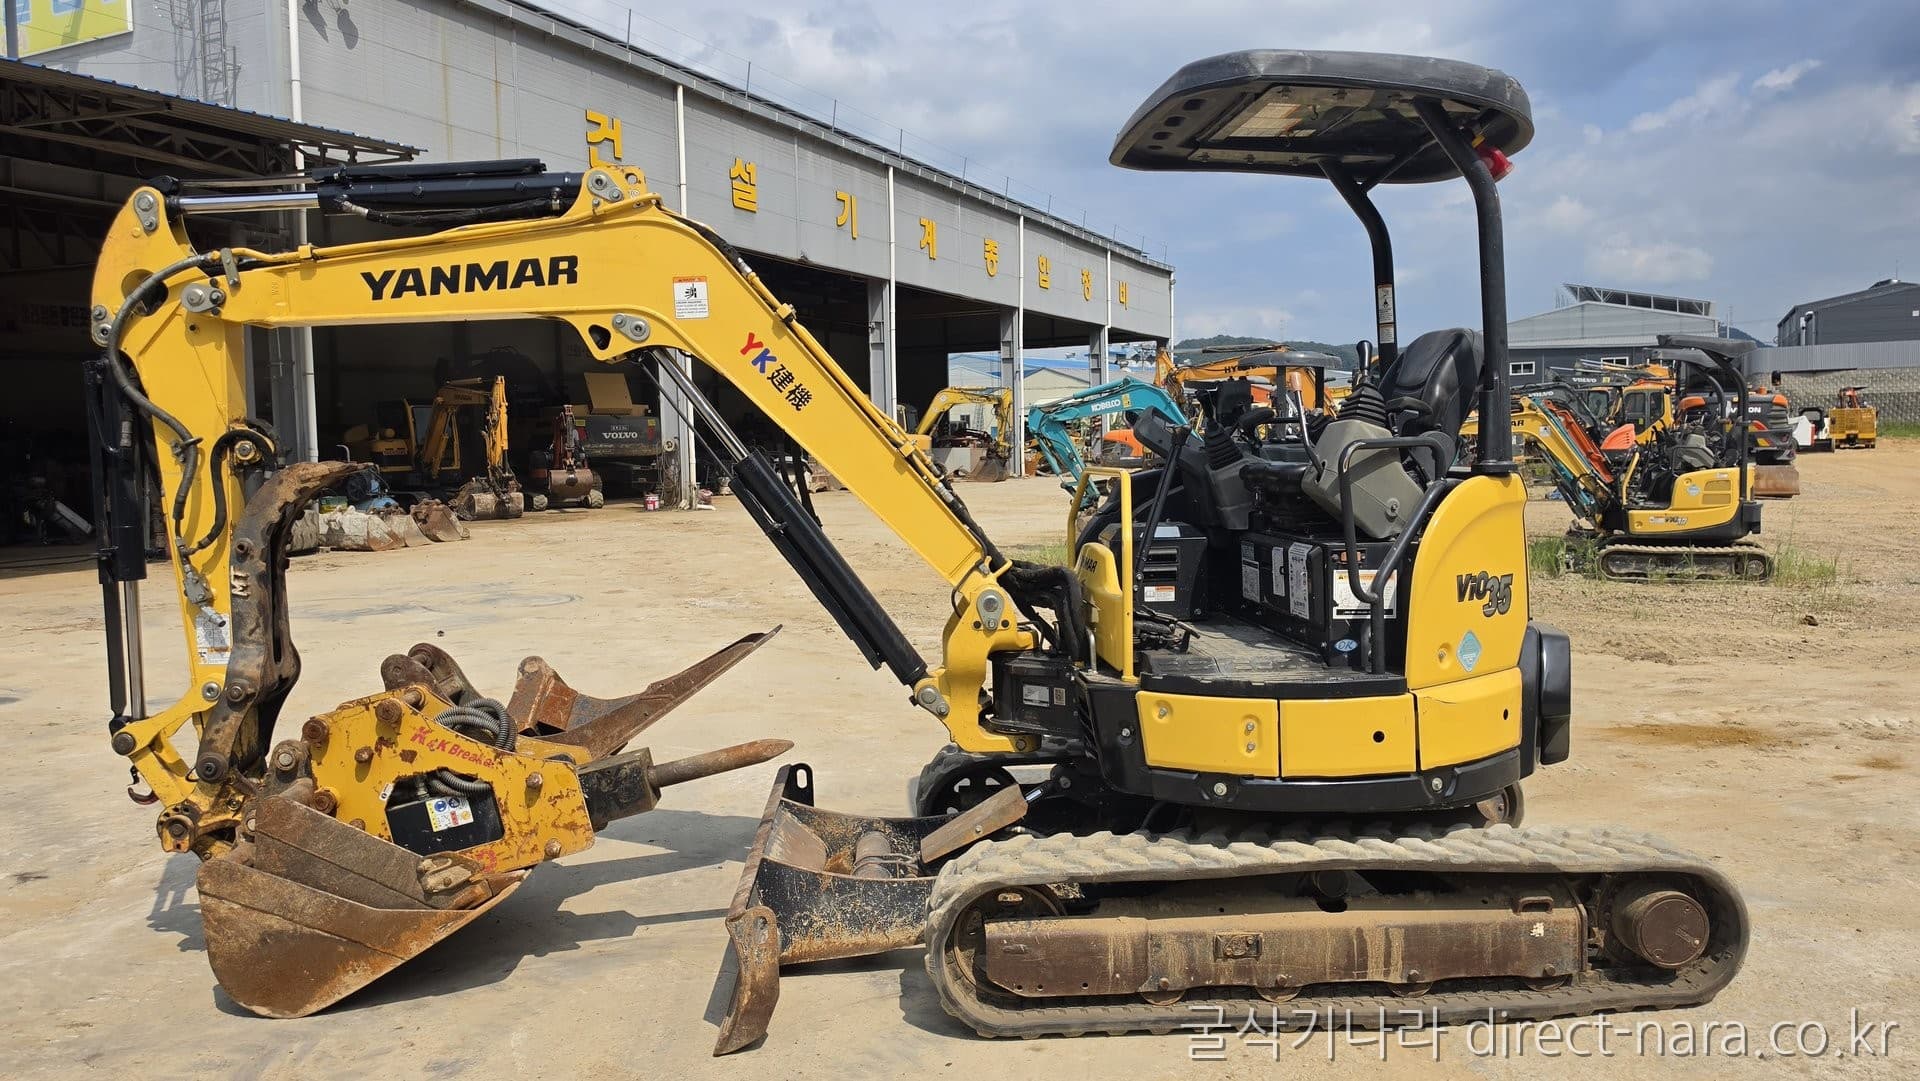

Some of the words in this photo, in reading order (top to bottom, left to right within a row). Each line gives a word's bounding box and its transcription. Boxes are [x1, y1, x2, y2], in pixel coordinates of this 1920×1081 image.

[360, 255, 578, 301] YANMAR
[1091, 399, 1121, 412] KOBELCO
[602, 431, 639, 440] VOLVO
[1338, 640, 1355, 650] OK
